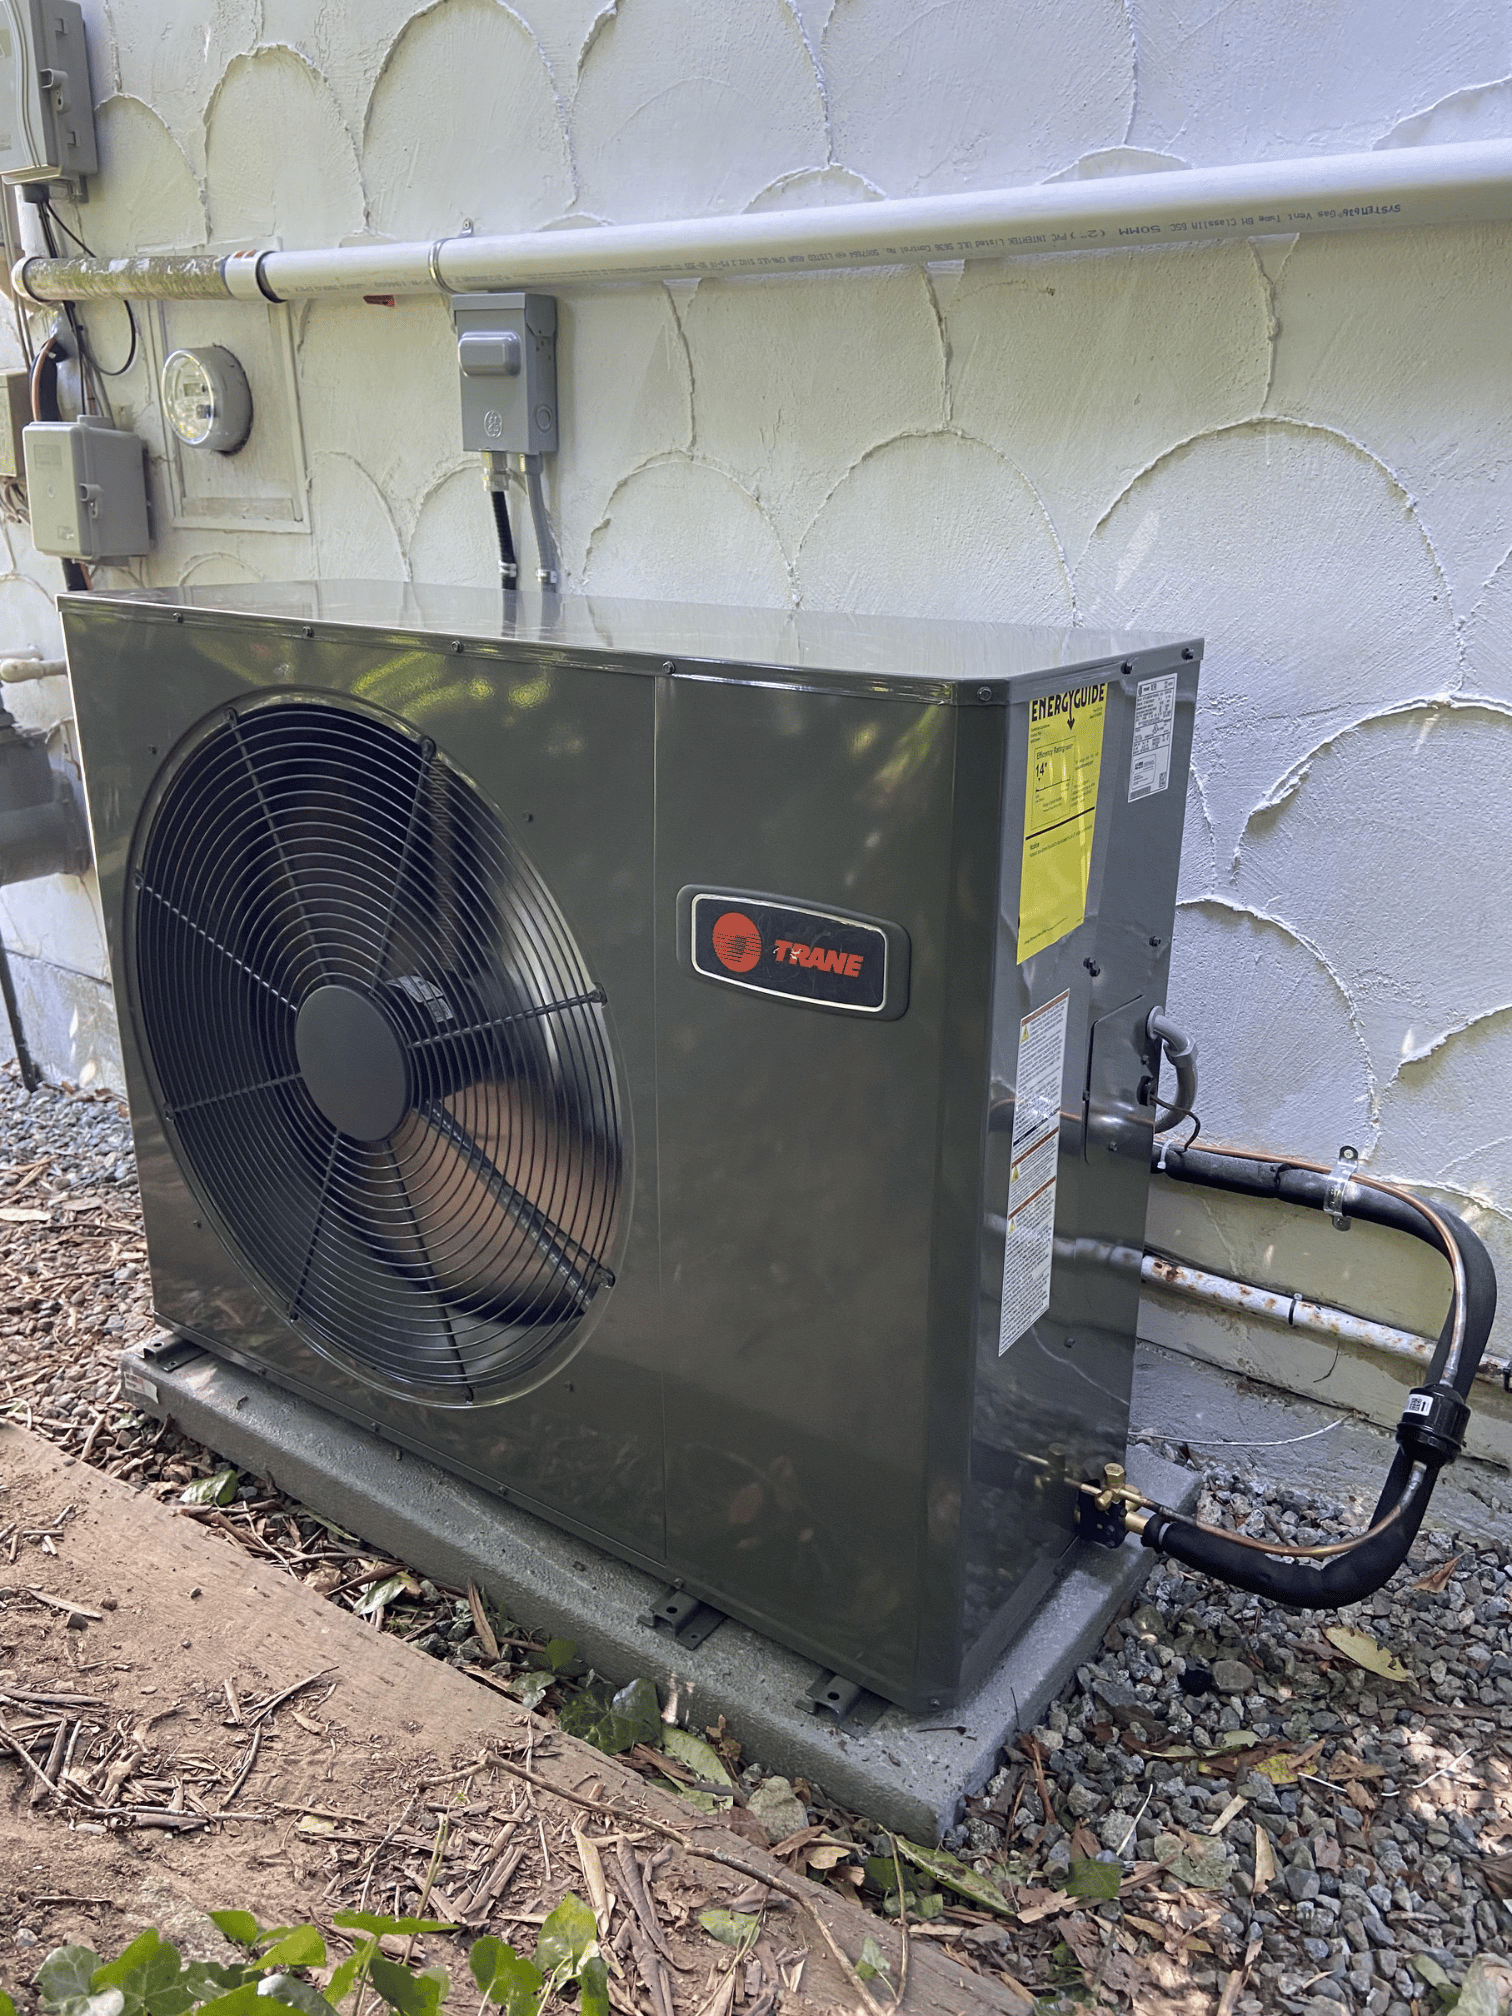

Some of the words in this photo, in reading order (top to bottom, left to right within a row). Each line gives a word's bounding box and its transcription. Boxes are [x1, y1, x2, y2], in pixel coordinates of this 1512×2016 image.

[1288, 211, 1311, 221] Vent
[1317, 209, 1335, 218] Gas
[1118, 224, 1160, 235] 50MM
[1007, 234, 1045, 245] INTERTEK
[1051, 232, 1066, 241] PVC
[975, 237, 1003, 247] Listed
[773, 938, 864, 979] TRANE
